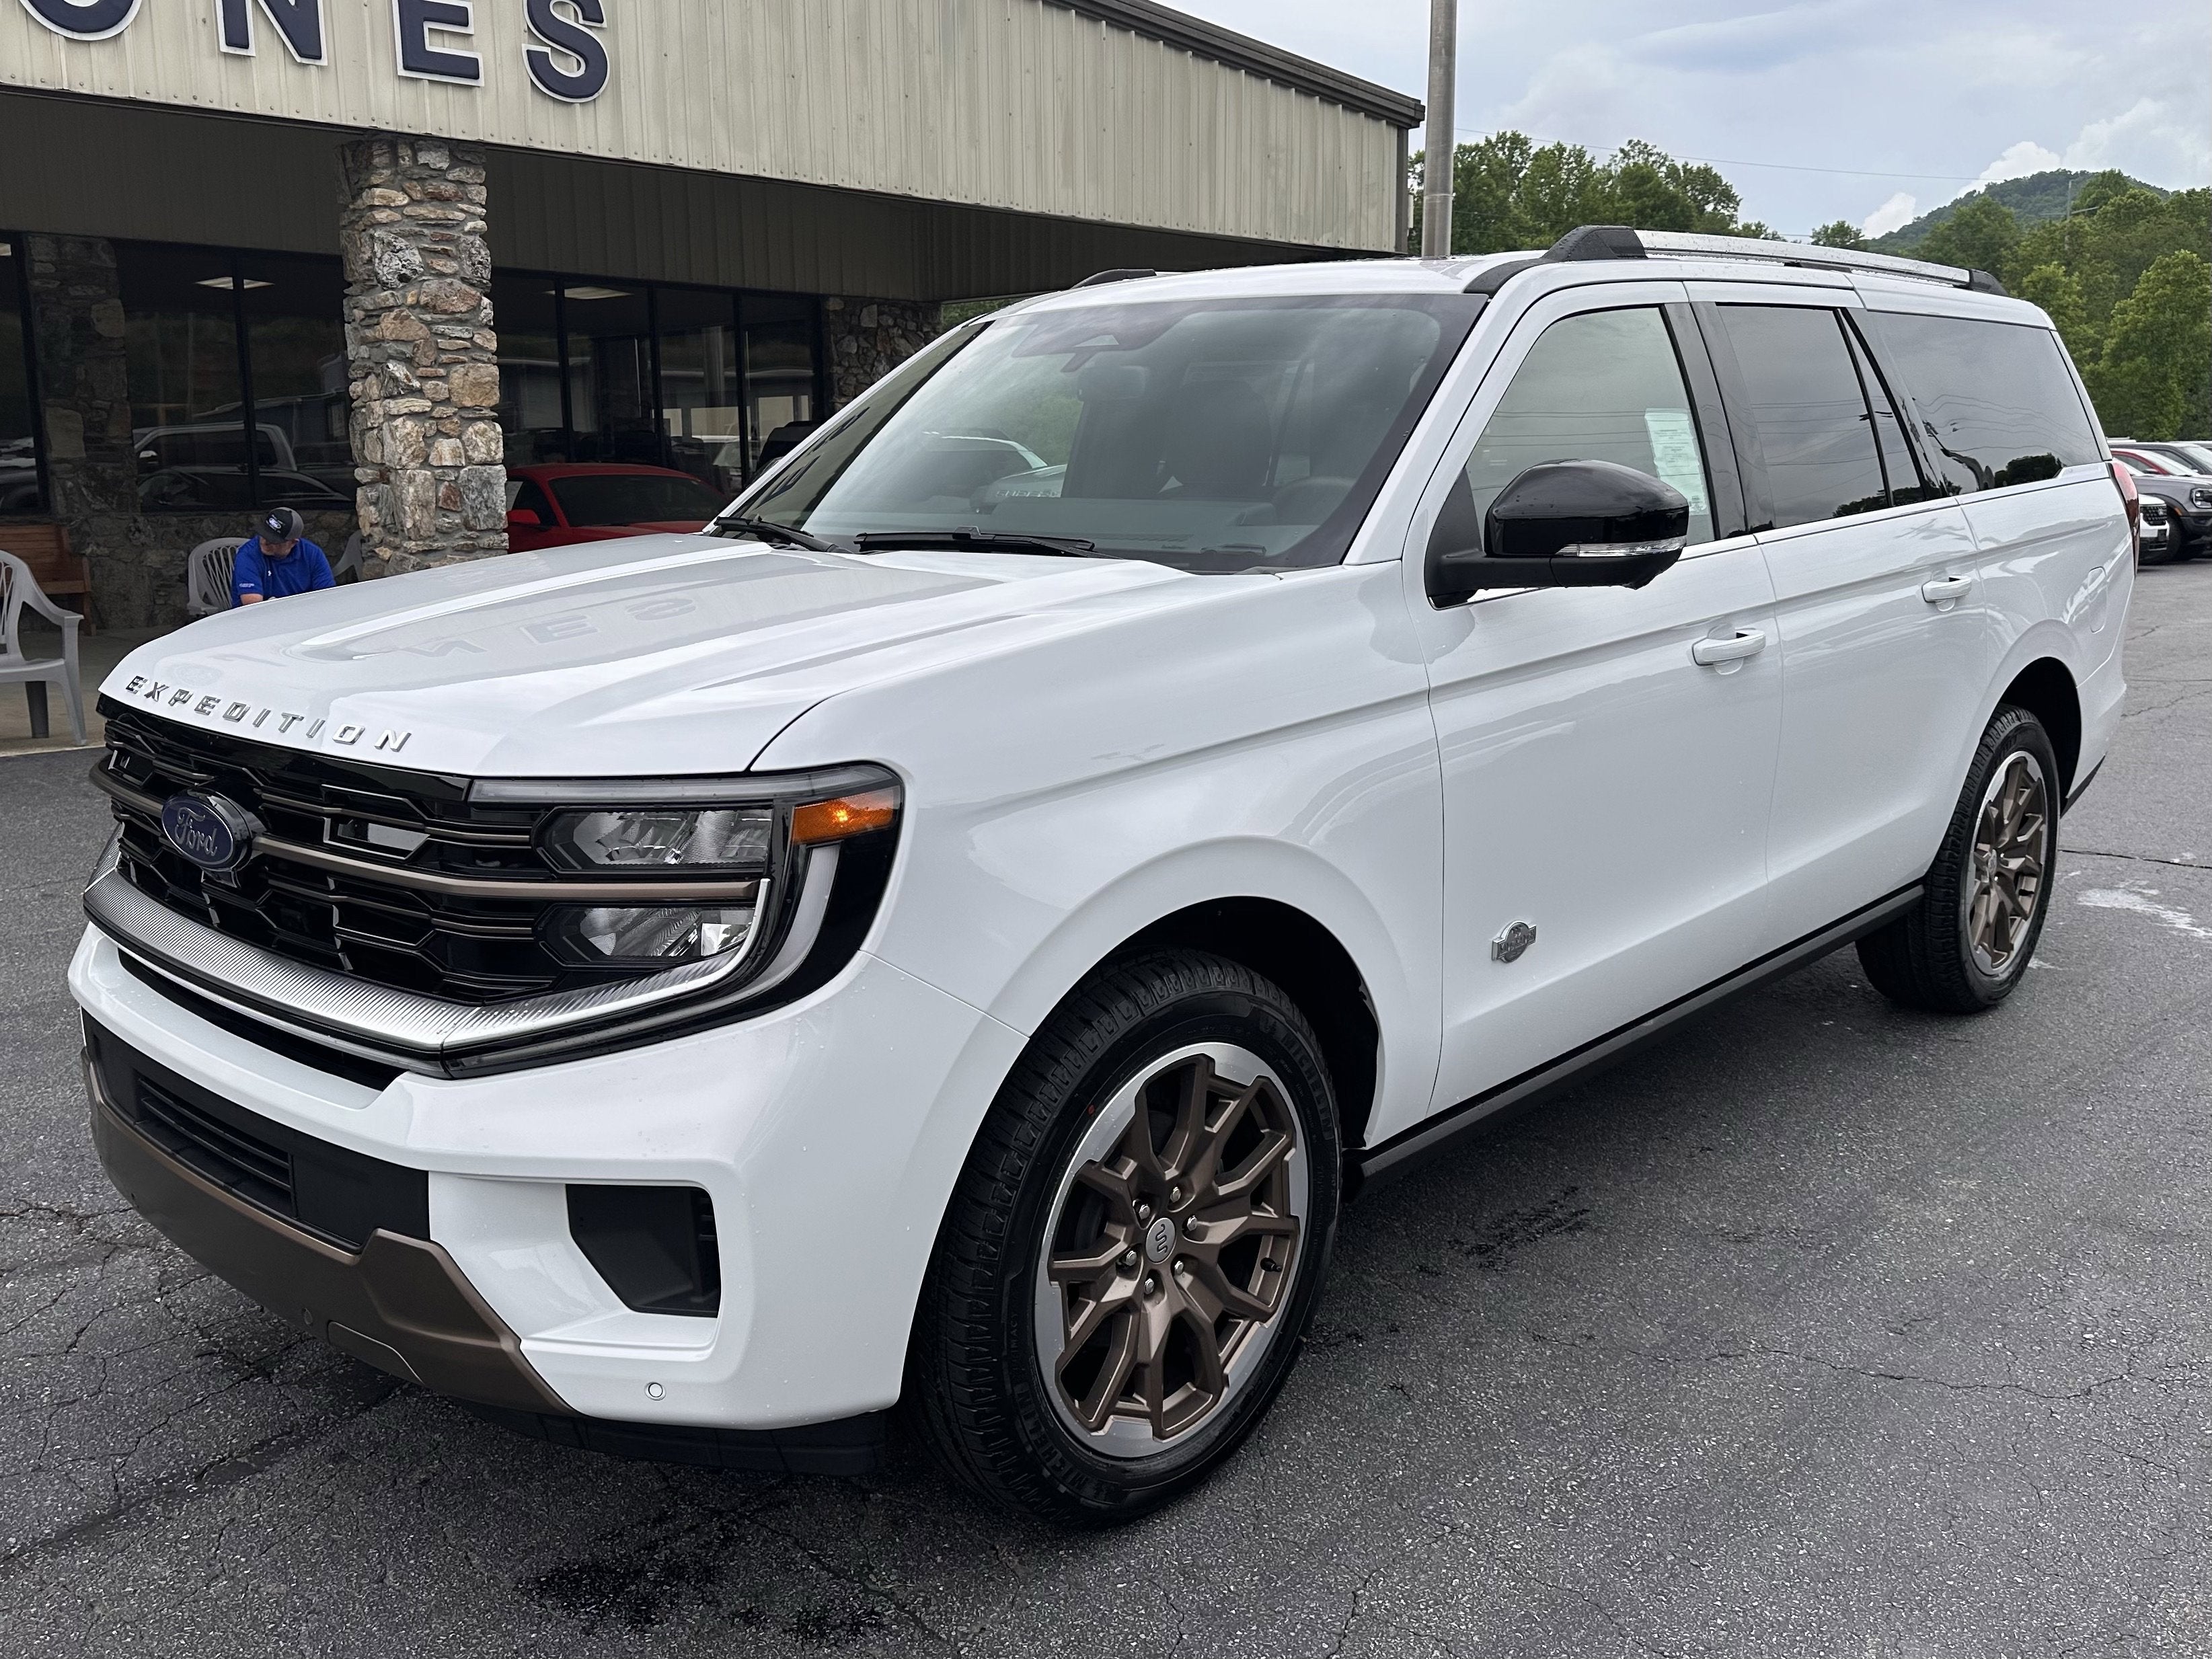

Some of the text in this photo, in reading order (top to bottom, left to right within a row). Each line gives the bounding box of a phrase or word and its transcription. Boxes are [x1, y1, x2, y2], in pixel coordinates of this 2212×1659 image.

[125, 675, 412, 753] EXPEDITION
[174, 806, 218, 857] Ford
[1281, 1032, 1333, 1134] MICHELIN
[1016, 1389, 1089, 1490] MICHELIN
